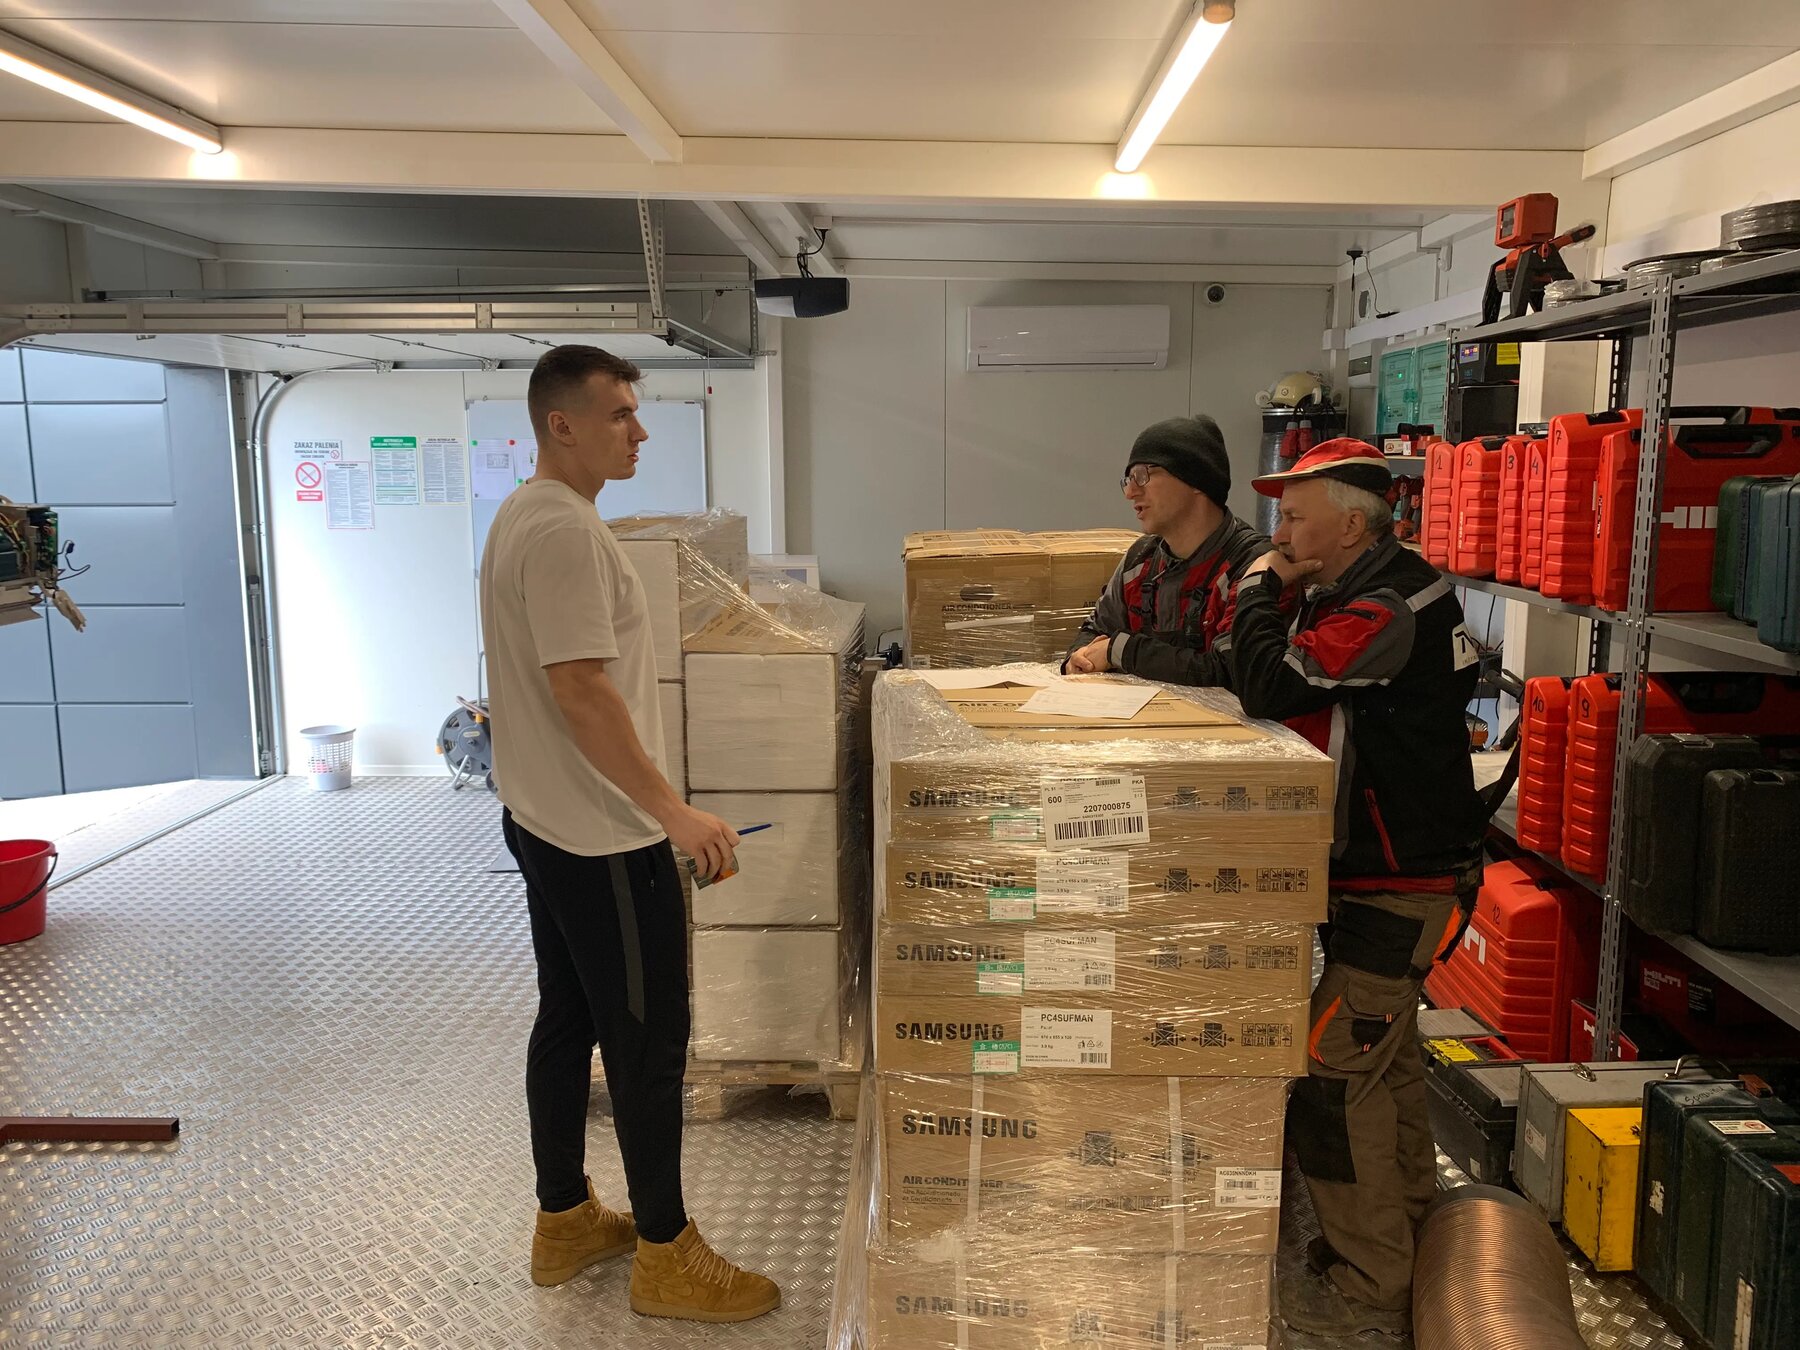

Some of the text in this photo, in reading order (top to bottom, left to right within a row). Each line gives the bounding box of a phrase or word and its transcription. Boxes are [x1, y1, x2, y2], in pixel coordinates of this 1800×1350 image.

[294, 441, 339, 449] ZAKAZ PALENIA
[1555, 429, 1562, 446] 7
[1435, 455, 1443, 470] 1
[1465, 453, 1473, 467] 2
[1507, 455, 1515, 470] 3
[1531, 456, 1539, 475] 4
[1532, 695, 1545, 713] 10
[1581, 698, 1590, 718] 9
[1047, 795, 1062, 804] 600
[1083, 801, 1131, 813] 2207000875
[905, 871, 1016, 889] SAMSUNG
[896, 944, 1006, 962] SAMSUNG
[1040, 1013, 1094, 1023] PC4SUFMAN
[895, 1022, 1004, 1040] SAMSUNG
[902, 1175, 1004, 1189] AIR CONDITNER
[896, 1295, 1029, 1318] SAMUNG
